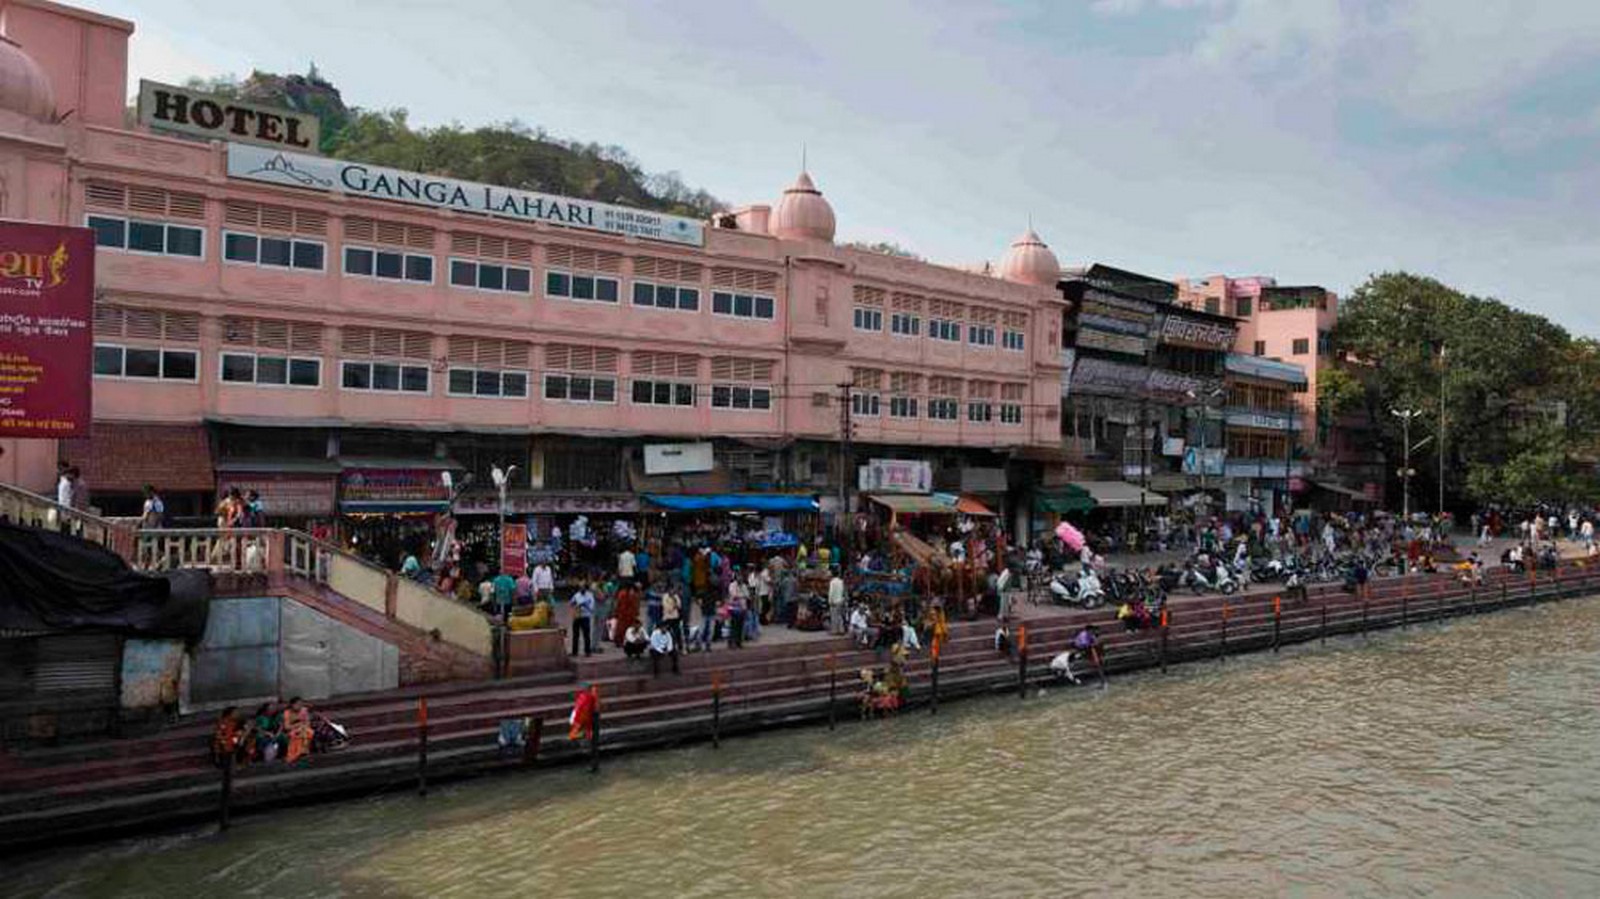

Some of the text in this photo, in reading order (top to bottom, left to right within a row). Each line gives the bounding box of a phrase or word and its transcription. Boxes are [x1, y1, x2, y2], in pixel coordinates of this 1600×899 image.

[153, 90, 309, 147] HOTEL
[341, 166, 593, 226] GANGA LAHARI
[25, 278, 42, 288] TV
